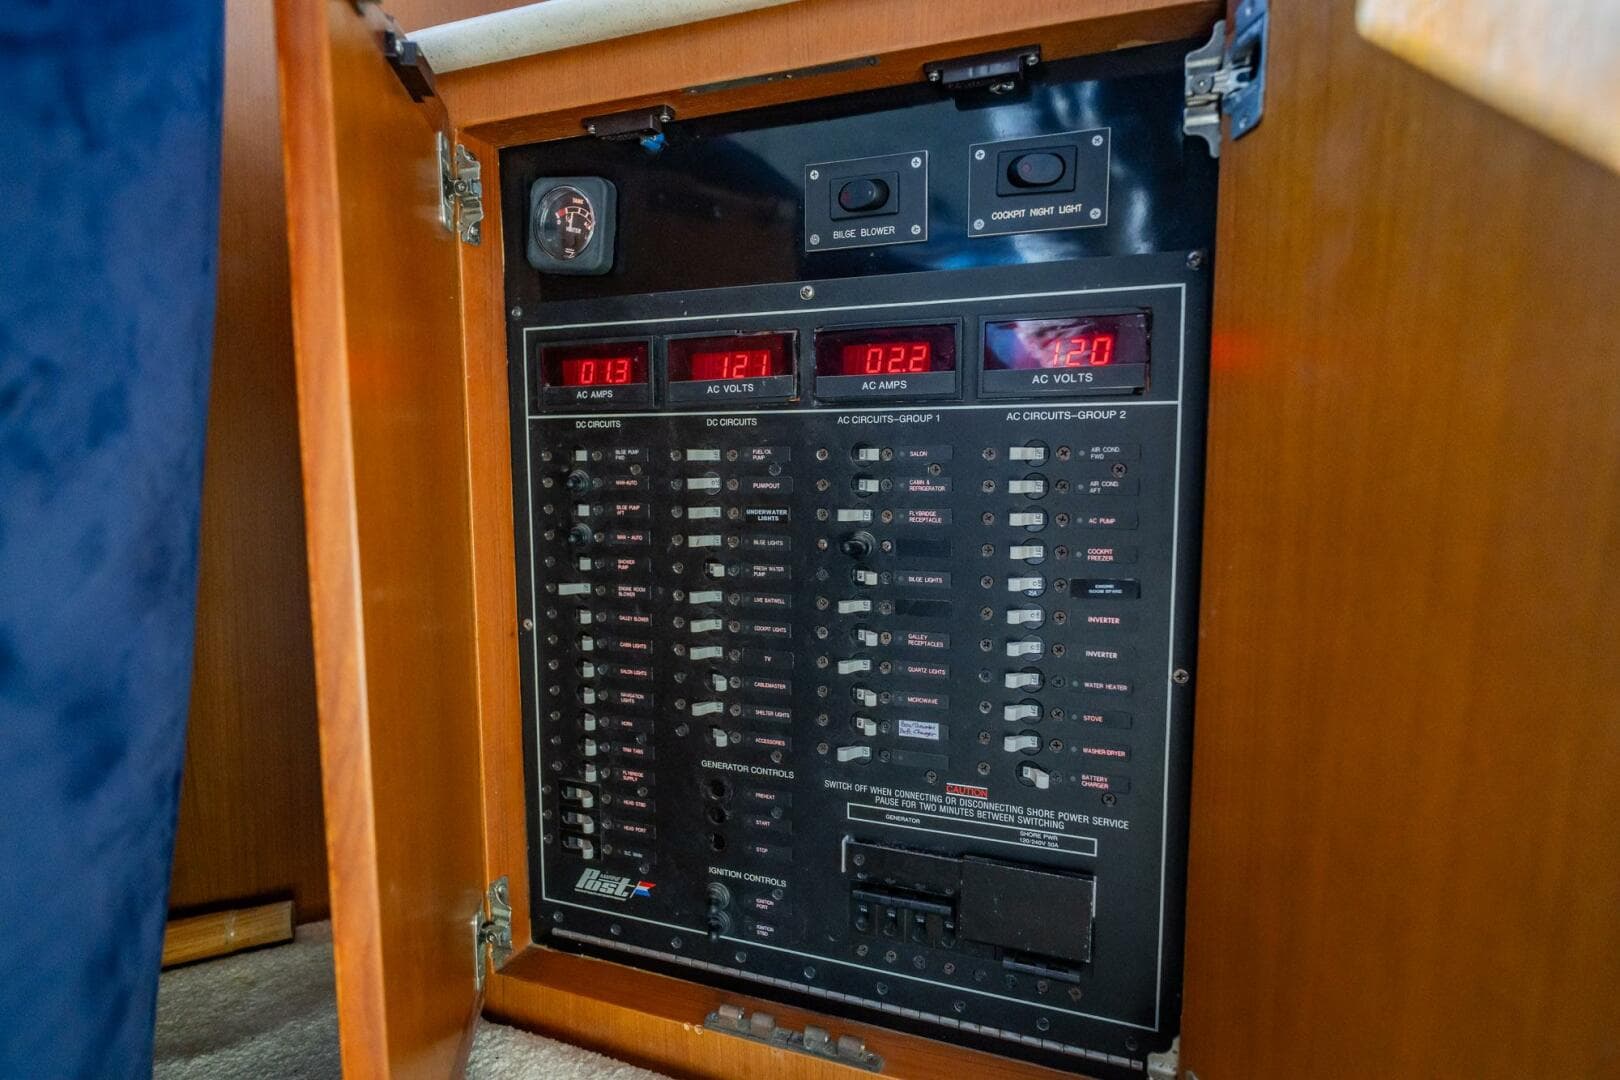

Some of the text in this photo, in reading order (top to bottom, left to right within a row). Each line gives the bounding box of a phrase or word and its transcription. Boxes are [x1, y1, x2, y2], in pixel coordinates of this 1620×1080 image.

[992, 204, 1082, 221] COCKPIT NIGHT LIGHT
[832, 226, 896, 240] BILGE BLOWER
[1052, 336, 1112, 367] 120
[722, 354, 767, 378] 121
[865, 347, 927, 374] 02.2
[1032, 372, 1093, 384] AC VOLTS
[706, 384, 754, 393] AC VOLTS
[862, 380, 907, 390] AC AMPS
[576, 390, 612, 399] AC AMPS
[838, 416, 850, 424] AC
[1006, 412, 1020, 420] AC
[1120, 410, 1126, 419] 2
[720, 418, 757, 426] CIRCUITS
[701, 760, 794, 778] GENERATOR CONTROLS
[946, 784, 988, 797] CAUTION
[824, 780, 1129, 830] SWITCH OFF WHEN CONNECTING OR DISCONNECTING SHORE POWER SERVICE
[875, 796, 1064, 830] PAUSE FOR TWO MINUTES BETWEEN SWITCHING
[886, 814, 920, 824] GENERATOR
[708, 866, 786, 887] IGNITION CONTROLS
